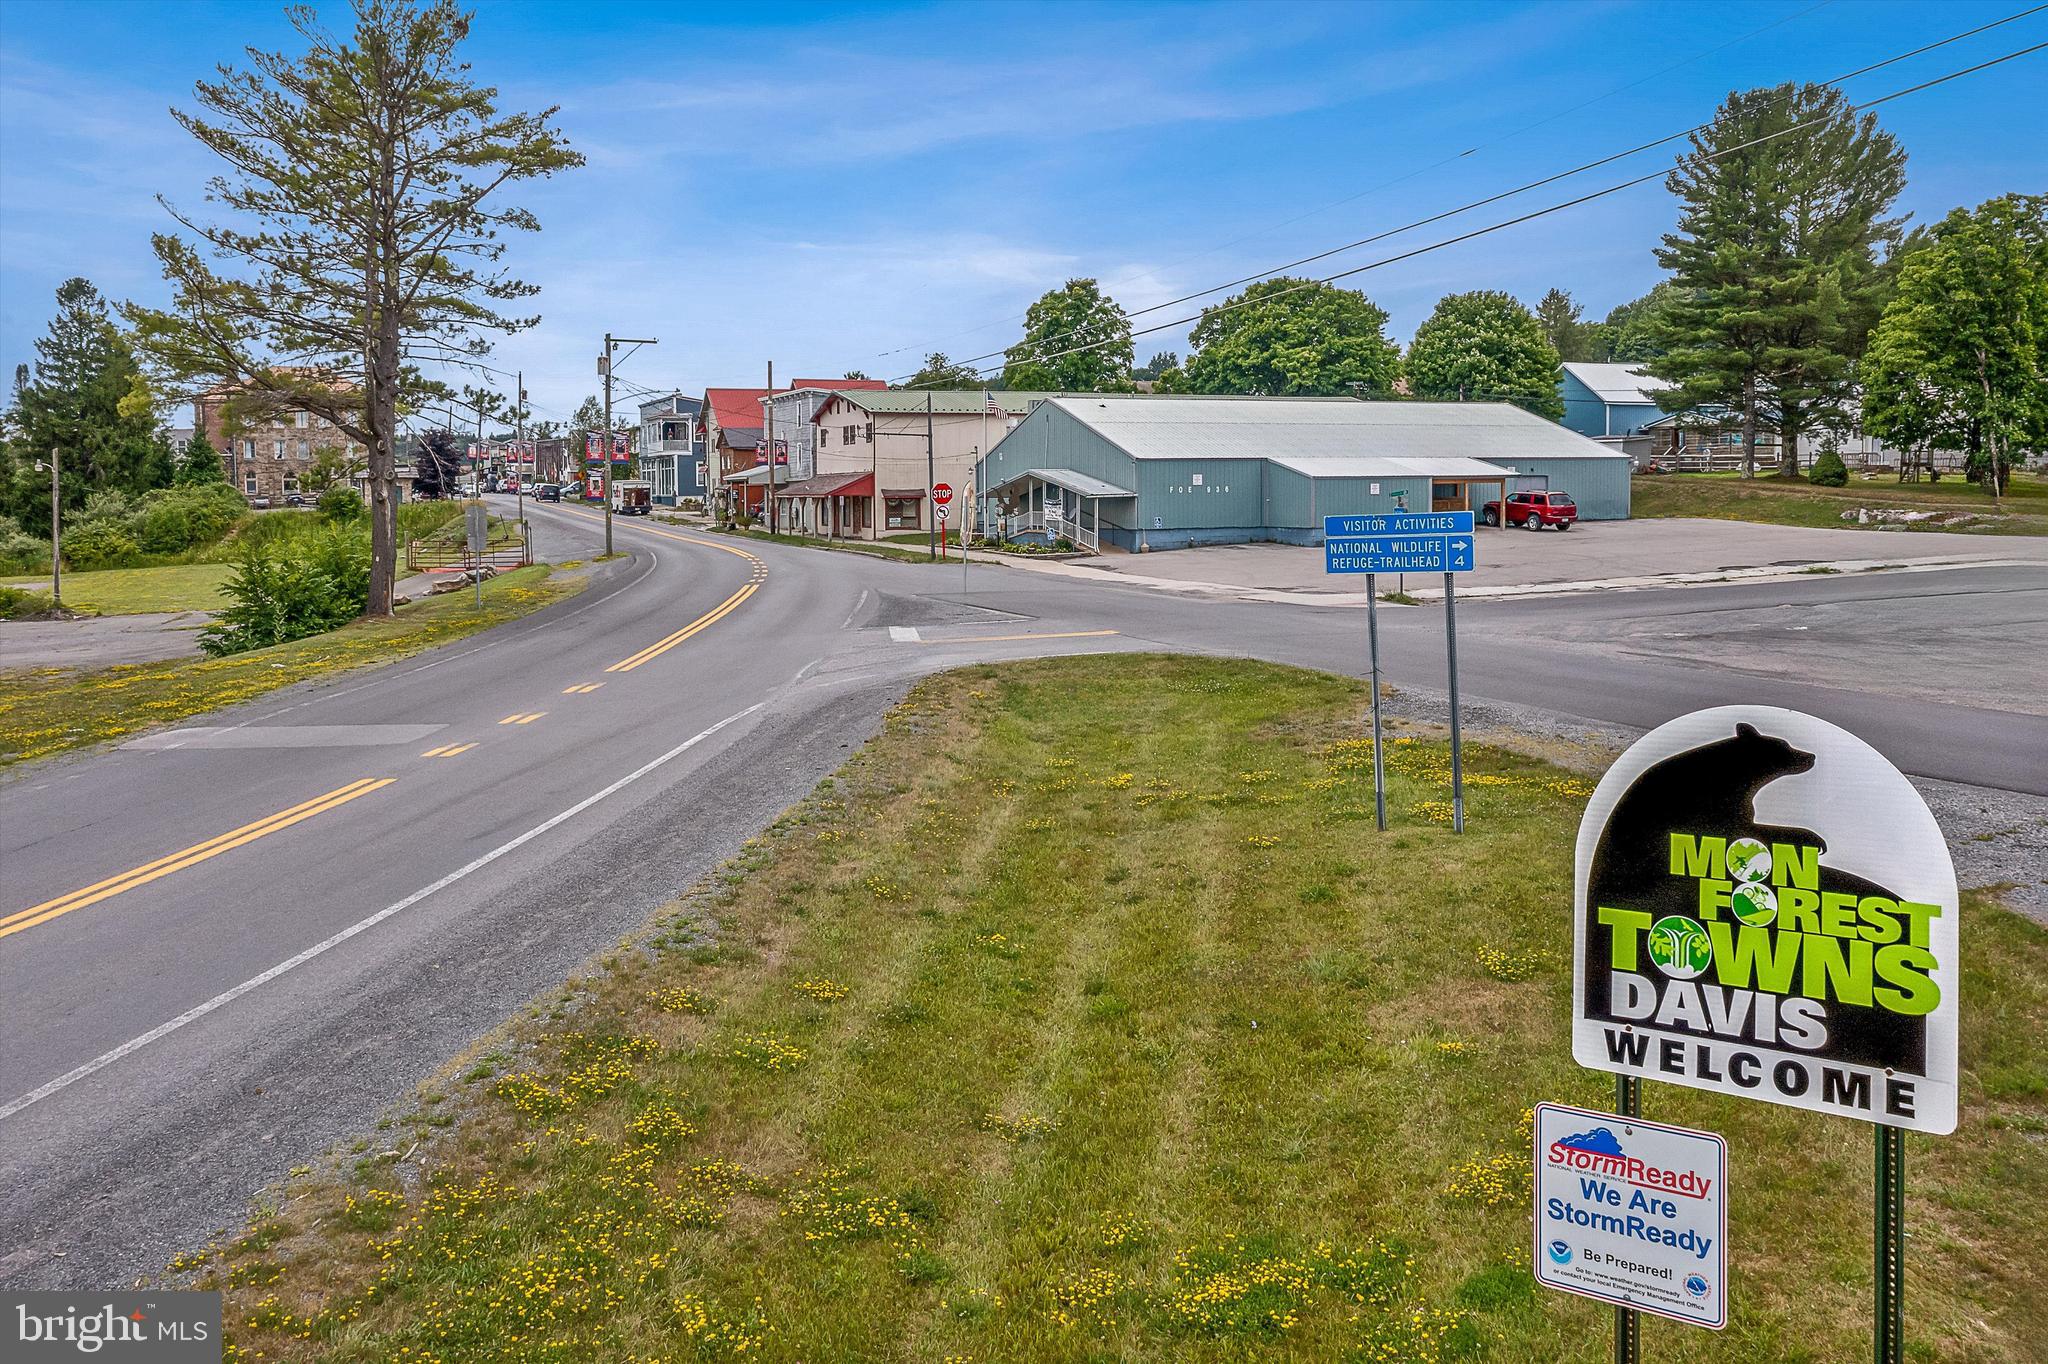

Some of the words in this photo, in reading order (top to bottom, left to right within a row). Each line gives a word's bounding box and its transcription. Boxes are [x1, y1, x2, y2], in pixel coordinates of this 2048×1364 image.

[933, 489, 951, 498] STOP
[1169, 486, 1192, 494] FOE
[1343, 519, 1386, 532] VISITOR
[1395, 517, 1454, 530] ACTIVITIES
[1330, 542, 1382, 554] NATIONAL
[1391, 540, 1441, 553] WILDLIFE
[1332, 556, 1440, 569] REFUGE-TRAILHEAD
[1454, 555, 1465, 567] 4
[1669, 832, 1819, 891] MON
[1699, 876, 1942, 948] FOREST
[1598, 906, 1942, 1016] TOWNS
[1610, 969, 1828, 1050] DAVIS
[1603, 1027, 1916, 1120] WELCOME
[1547, 1162, 1572, 1172] NATIONAL
[1574, 1169, 1601, 1178] WEATHER
[1548, 1142, 1712, 1199] StormReady
[1579, 1177, 1621, 1207] We
[1628, 1189, 1677, 1219] Are
[1547, 1198, 1712, 1260] StormReady
[1575, 1266, 1584, 1274] Go
[1583, 1248, 1602, 1263] Be
[1605, 1253, 1673, 1281] Prepared!
[1560, 1270, 1582, 1280] contact
[1582, 1275, 1596, 1283] your
[1597, 1279, 1612, 1287] local
[1612, 1282, 1646, 1297] Emergency
[1647, 1291, 1686, 1307] Management
[1686, 1301, 1705, 1311] Office
